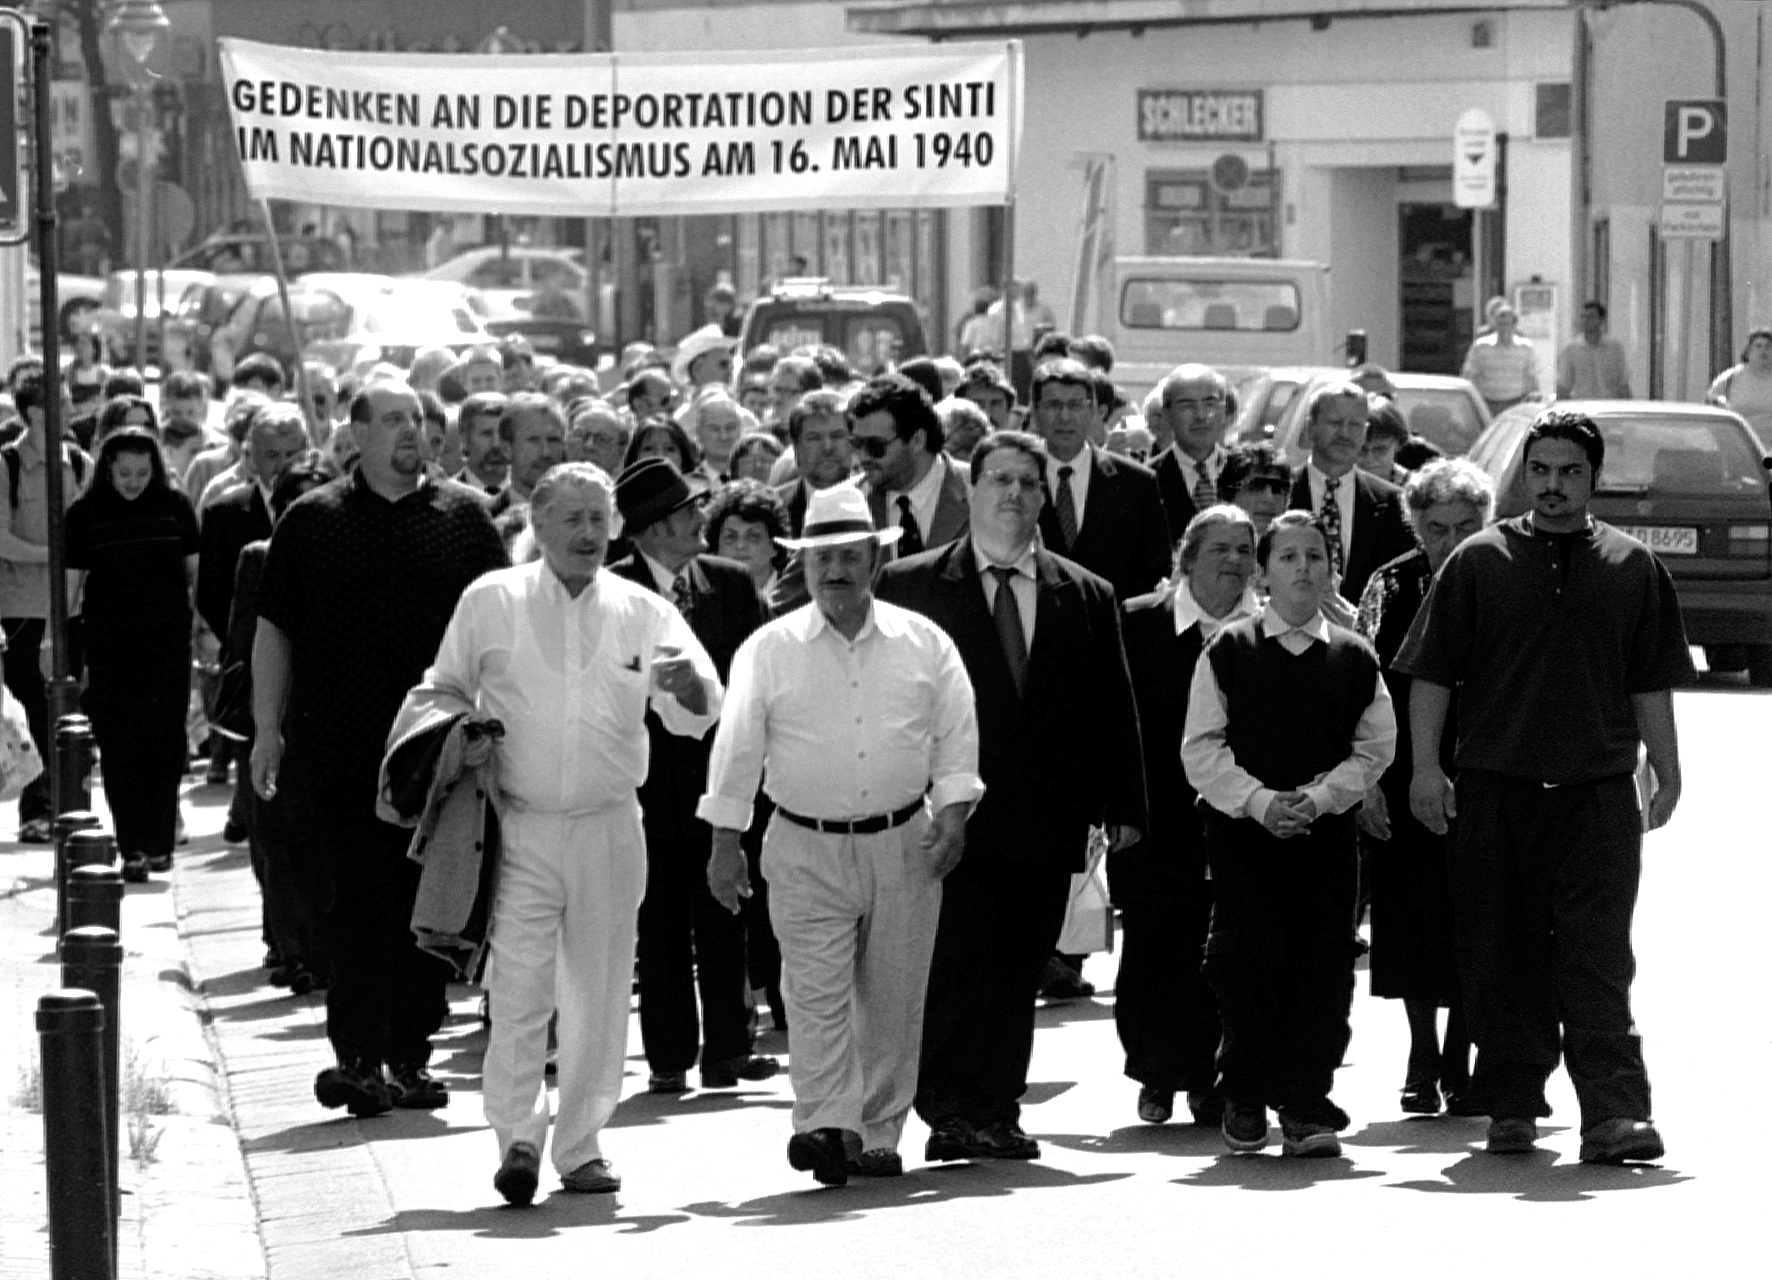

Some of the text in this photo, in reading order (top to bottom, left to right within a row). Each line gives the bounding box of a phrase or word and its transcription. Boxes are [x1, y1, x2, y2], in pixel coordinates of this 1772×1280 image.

[232, 79, 995, 130] GEDENKEN AN DIE DEPORTATION DER SINTI
[1142, 94, 1258, 136] SCHLECKER
[238, 126, 995, 179] IM NATIONALSOZIALISMUS AM 16. MAI 1940
[1677, 106, 1713, 158] P
